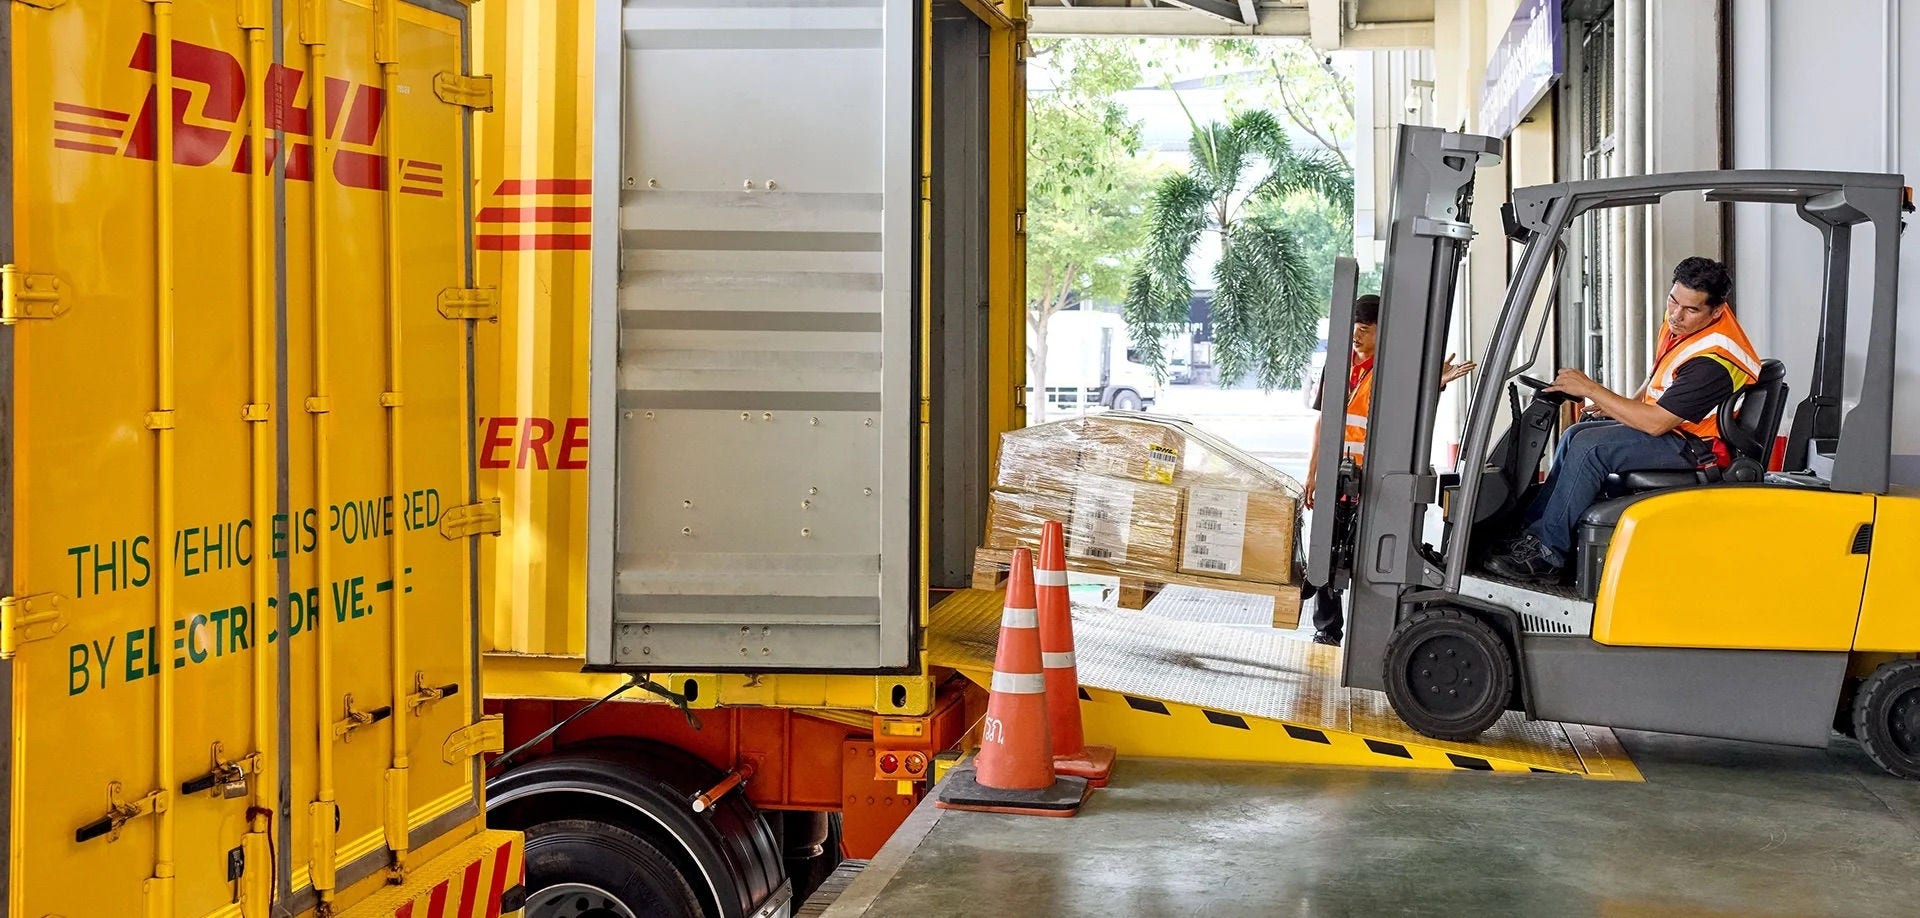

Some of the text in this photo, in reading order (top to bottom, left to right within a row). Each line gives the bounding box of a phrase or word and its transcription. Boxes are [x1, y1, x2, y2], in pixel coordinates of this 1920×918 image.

[123, 32, 388, 192] DHL
[479, 416, 588, 470] ERE
[68, 535, 150, 598] THIS
[295, 508, 317, 554] IS
[69, 636, 115, 696] BY
[288, 576, 373, 638] DRVE.
